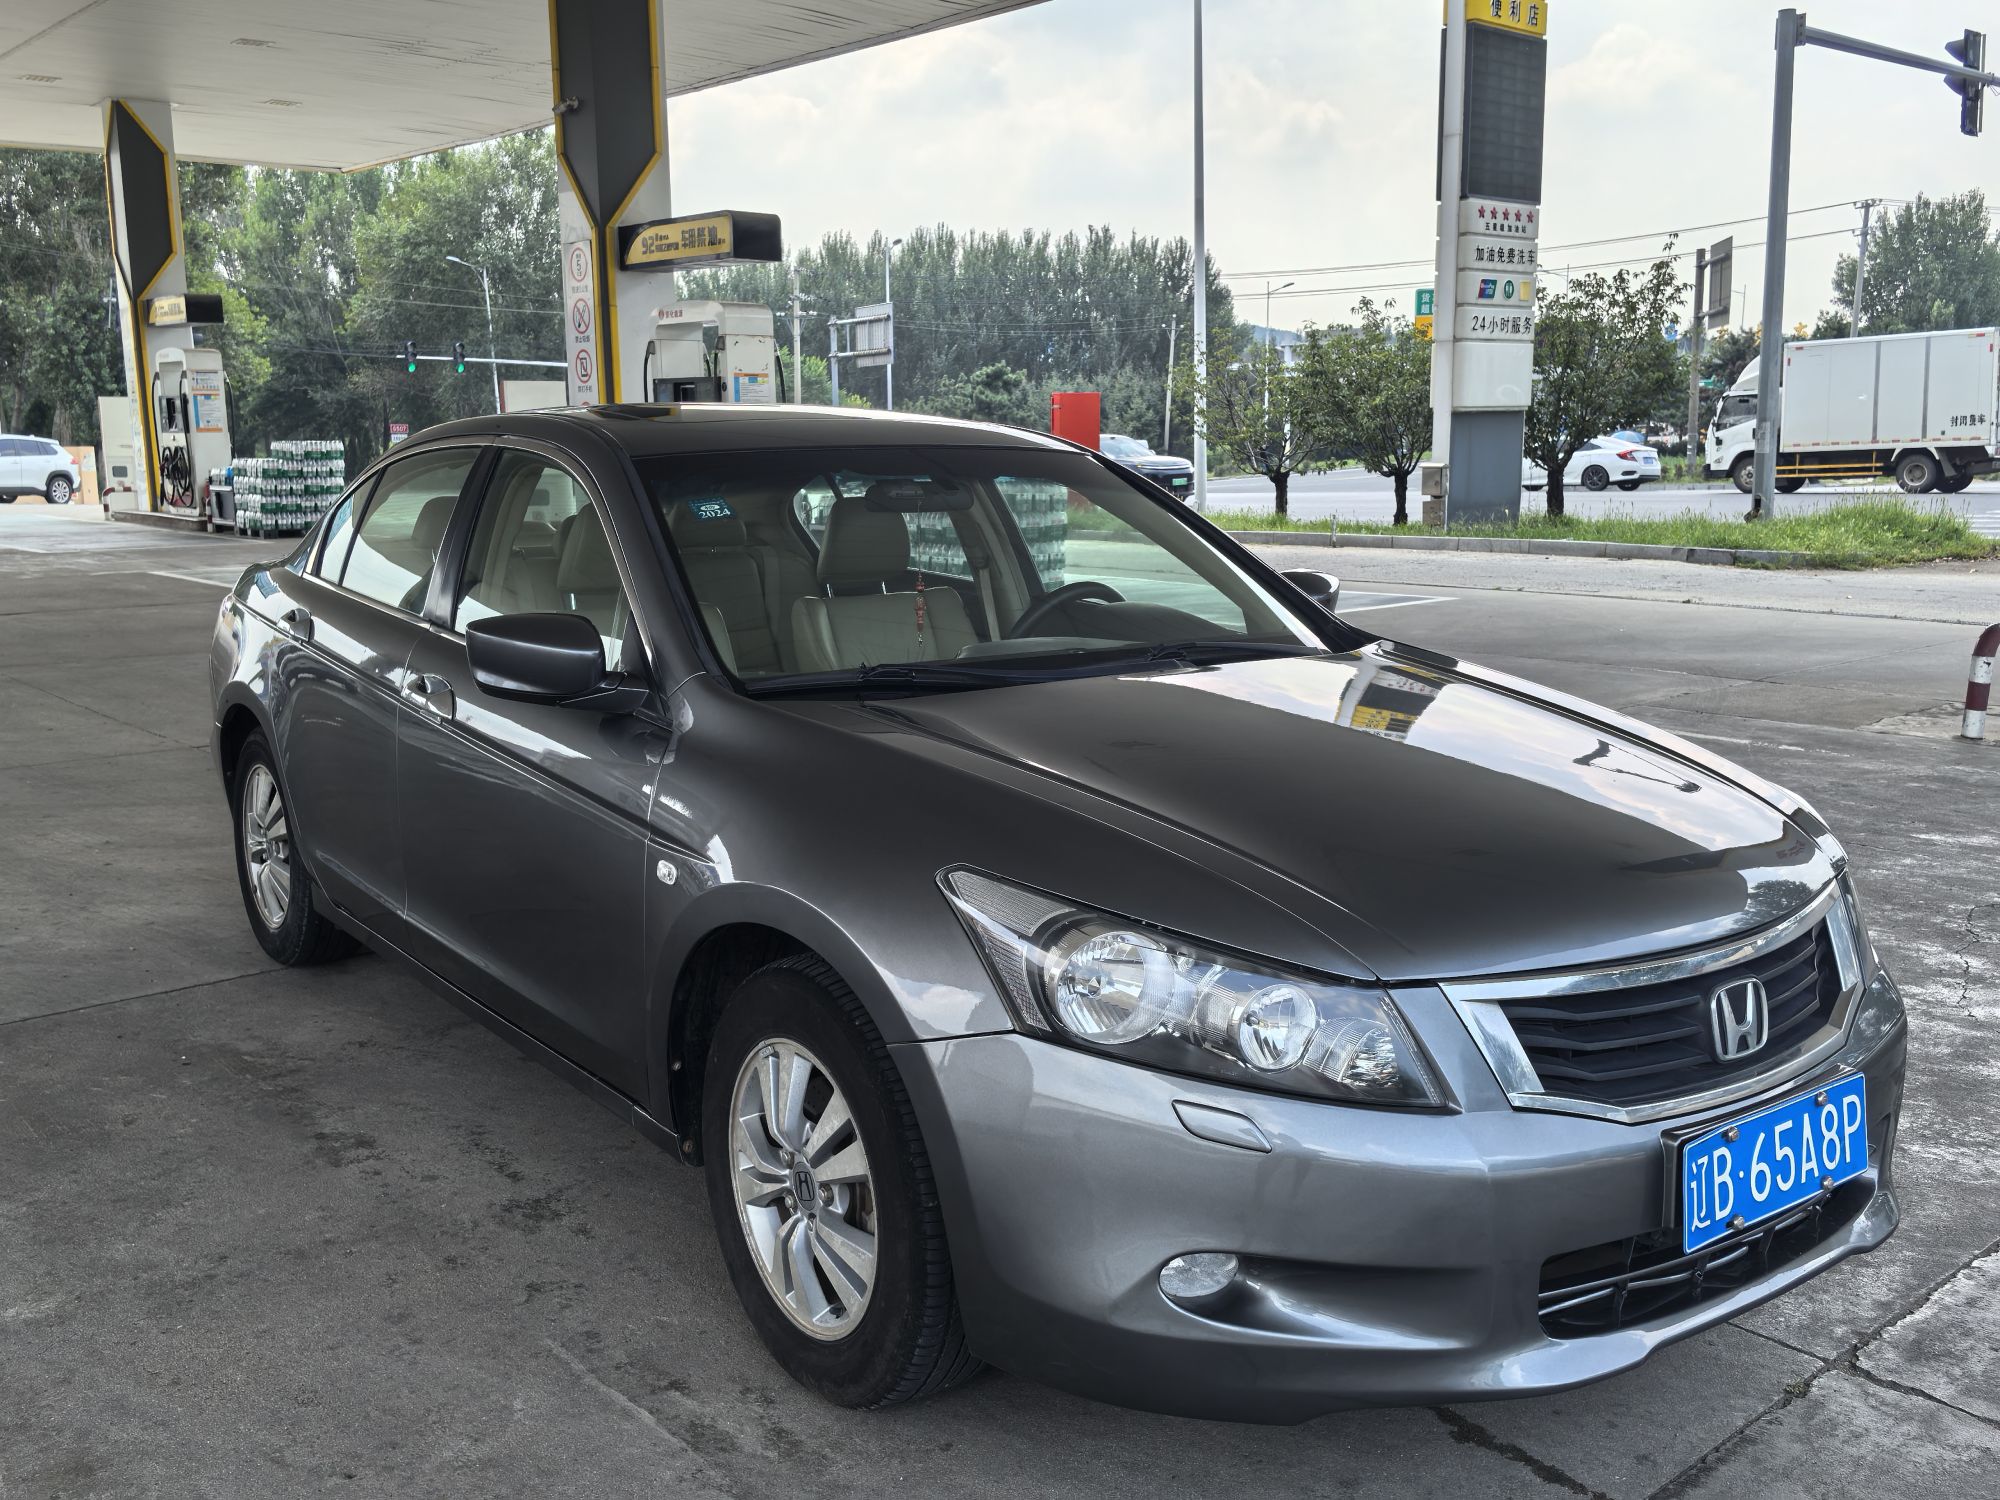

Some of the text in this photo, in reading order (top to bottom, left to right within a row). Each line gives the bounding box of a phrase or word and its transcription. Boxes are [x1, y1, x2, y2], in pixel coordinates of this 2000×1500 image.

[1490, 0, 1539, 27] 便利店
[642, 236, 655, 255] 92
[1475, 244, 1536, 265] 加油免费洗车
[1471, 315, 1533, 335] 24小时服务
[699, 508, 731, 519] 2024
